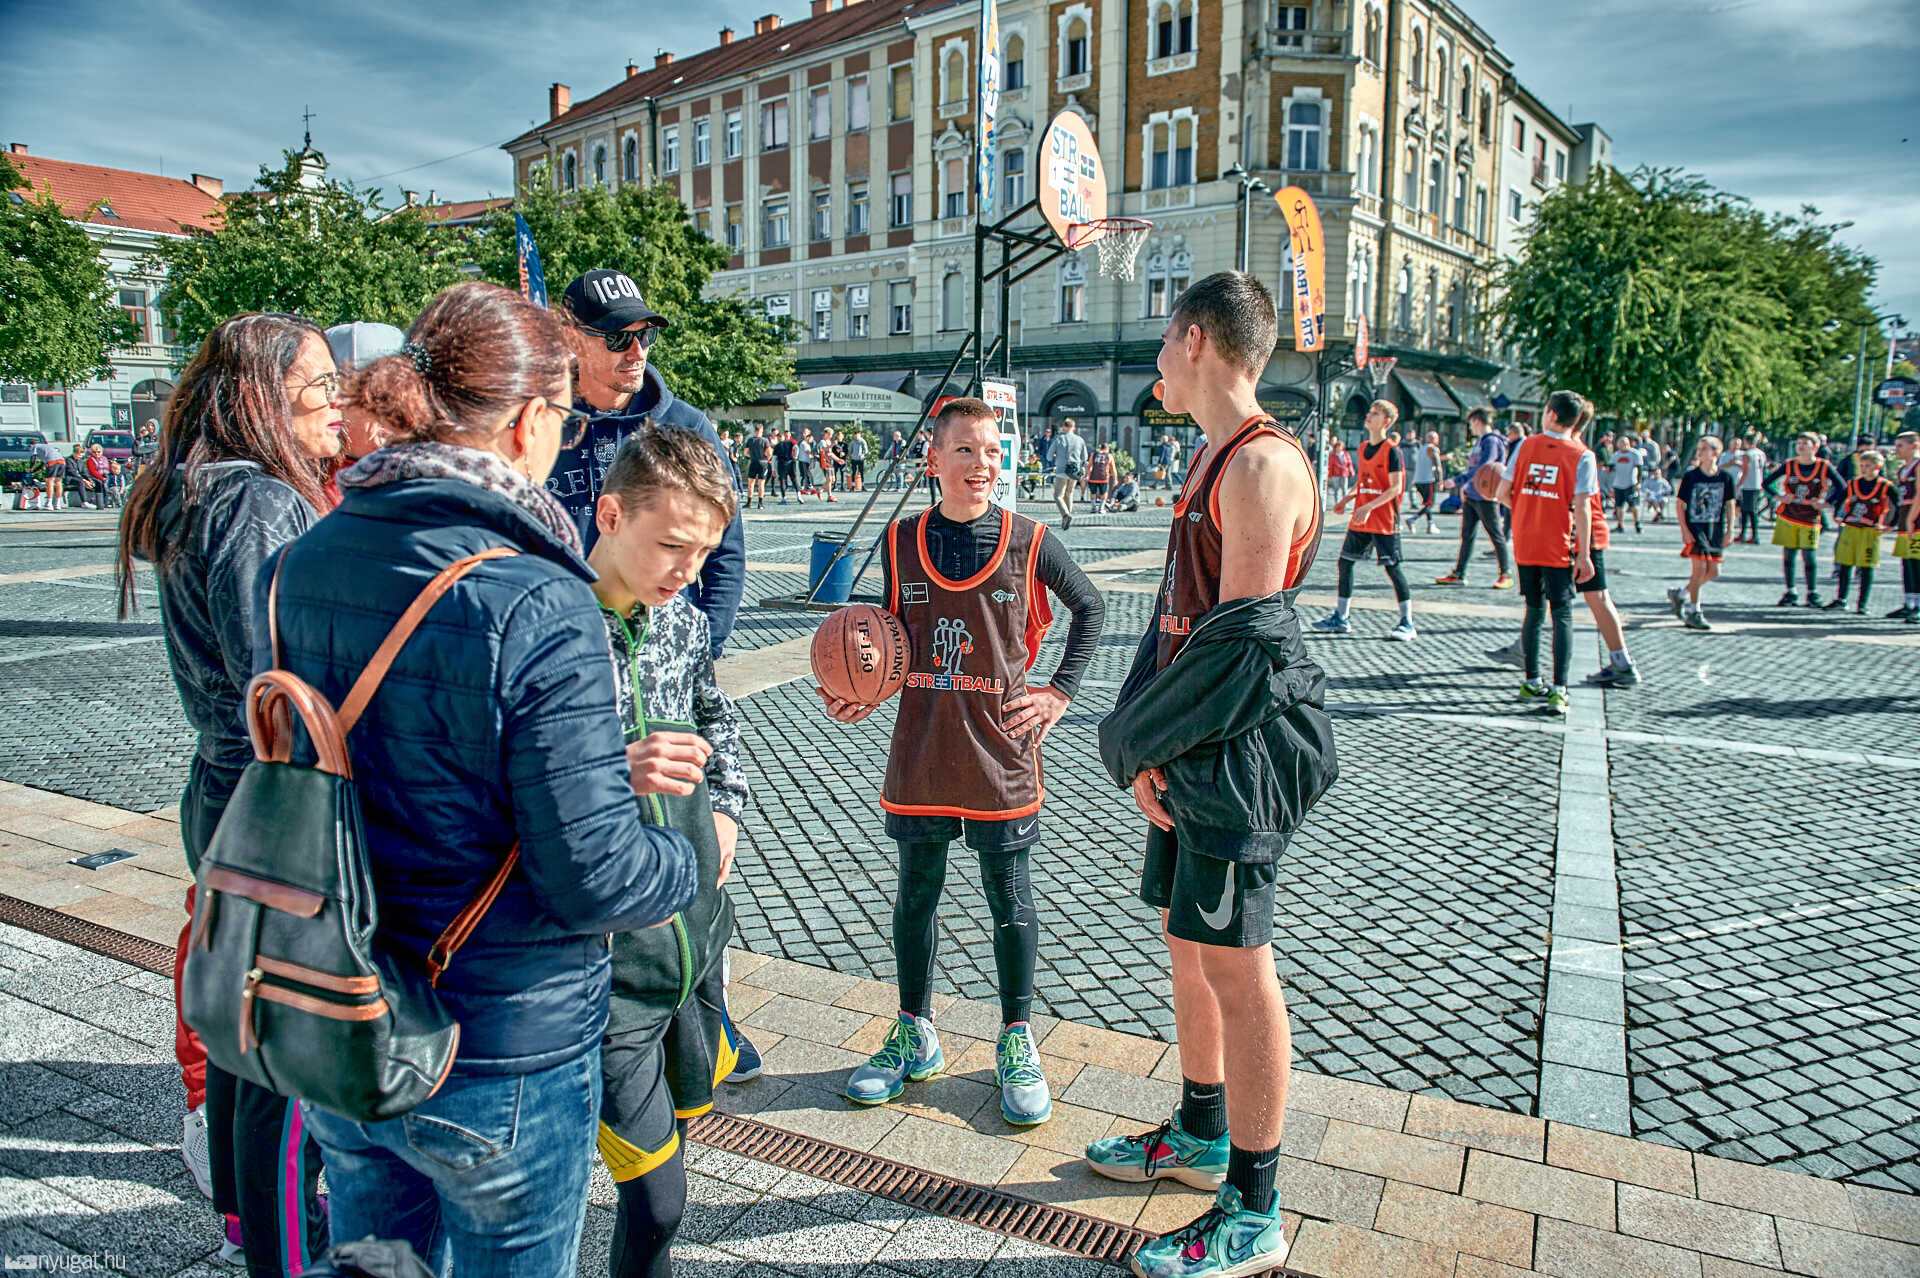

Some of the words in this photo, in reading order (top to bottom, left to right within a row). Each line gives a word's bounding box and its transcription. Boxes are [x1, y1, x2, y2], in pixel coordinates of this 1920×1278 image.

[1052, 125, 1078, 165] STR
[857, 620, 874, 673] TF-150
[880, 615, 904, 681] SPALDING
[906, 673, 1004, 694] STREETBALL
